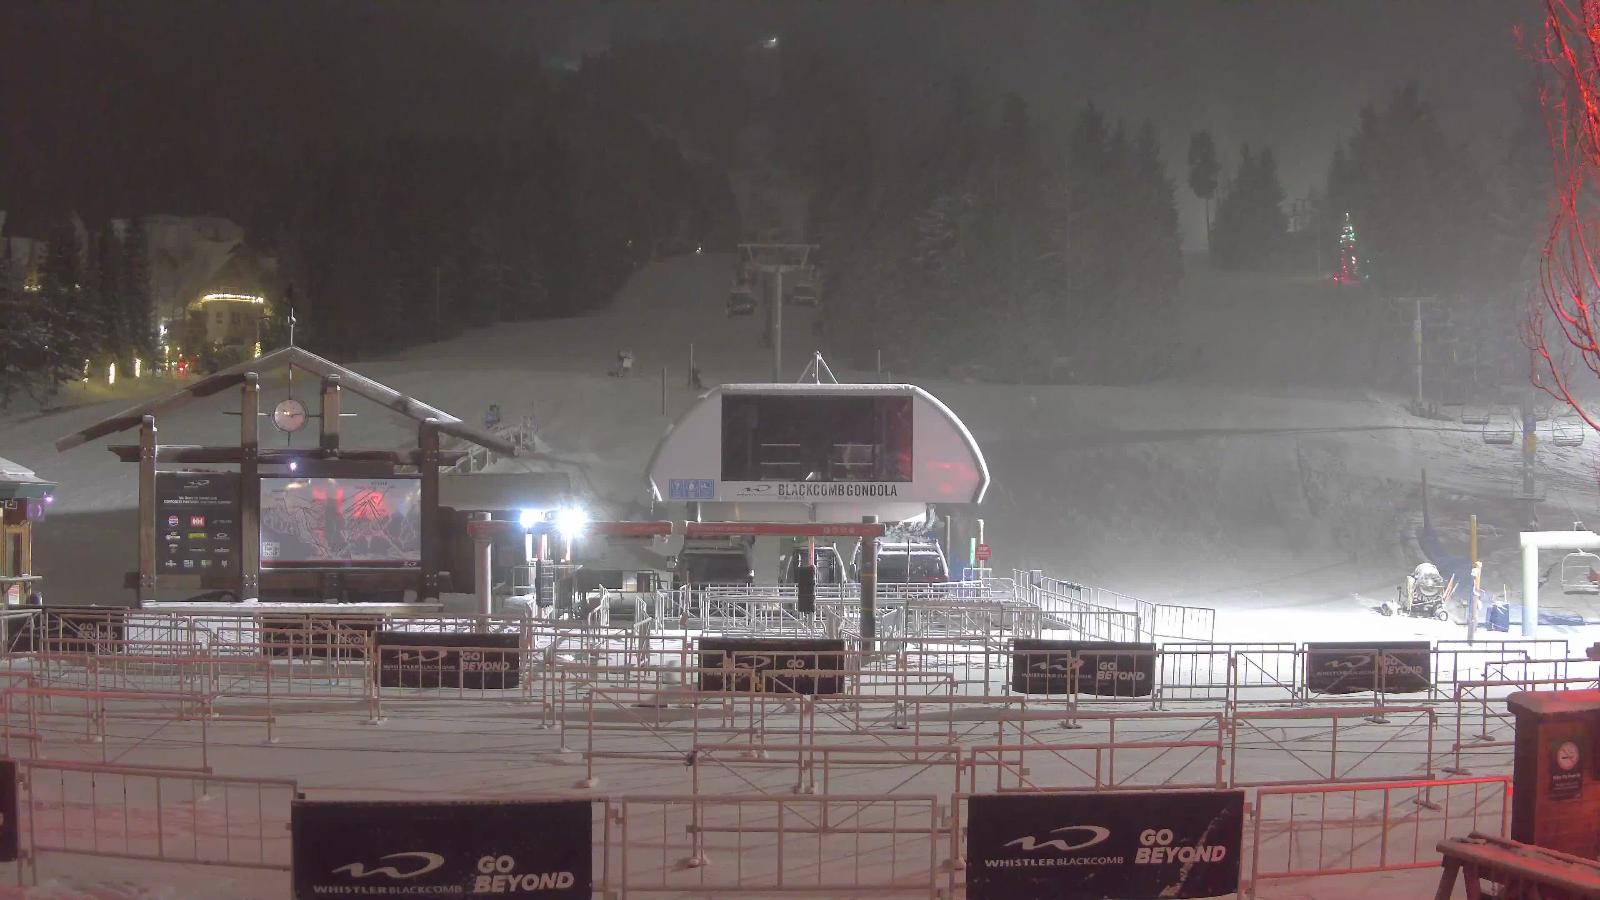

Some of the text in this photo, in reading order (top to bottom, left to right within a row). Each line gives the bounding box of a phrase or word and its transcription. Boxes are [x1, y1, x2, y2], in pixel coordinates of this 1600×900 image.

[462, 651, 481, 661] GO
[462, 661, 510, 671] BEYOND
[786, 659, 805, 669] GO
[1099, 661, 1117, 671] GO
[1096, 670, 1145, 681] BEYOND
[1139, 828, 1173, 846] GO
[1135, 845, 1227, 864] BEYOND
[477, 854, 515, 874] GO
[473, 872, 575, 893] BEYOND
